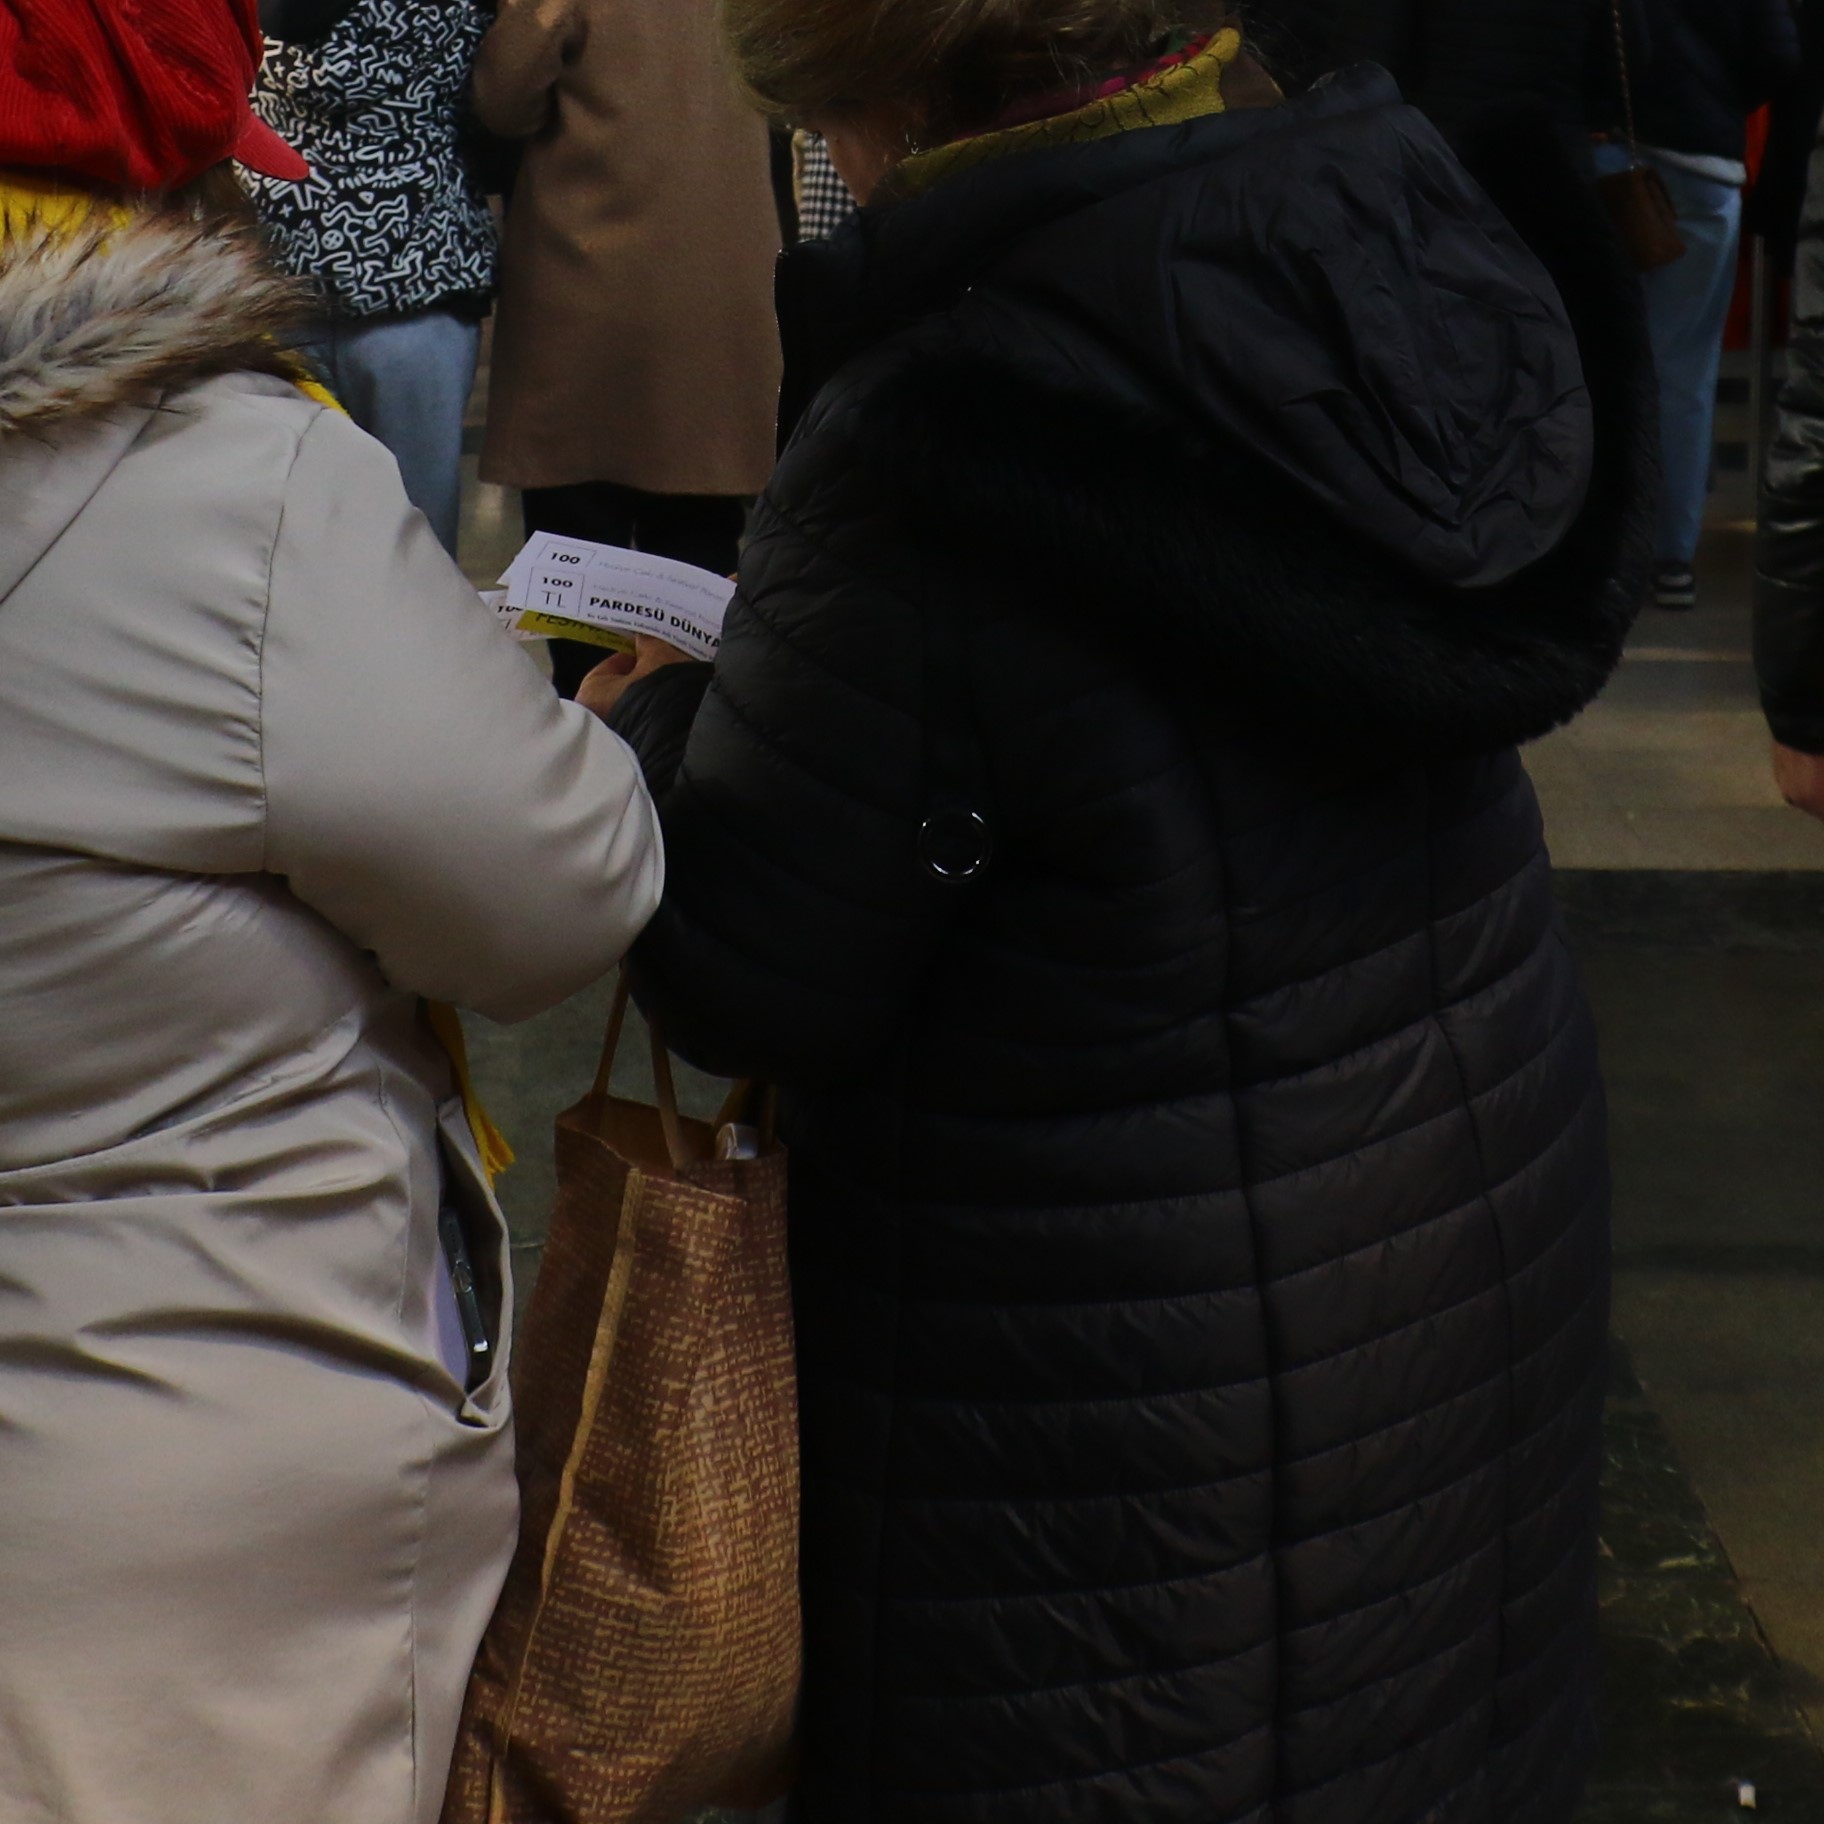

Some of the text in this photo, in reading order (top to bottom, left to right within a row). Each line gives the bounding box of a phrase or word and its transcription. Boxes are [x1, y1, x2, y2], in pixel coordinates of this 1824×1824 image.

[551, 552, 581, 565] 100
[542, 577, 573, 588] 100
[541, 591, 566, 609] TL
[589, 596, 665, 622] PARDESÜ
